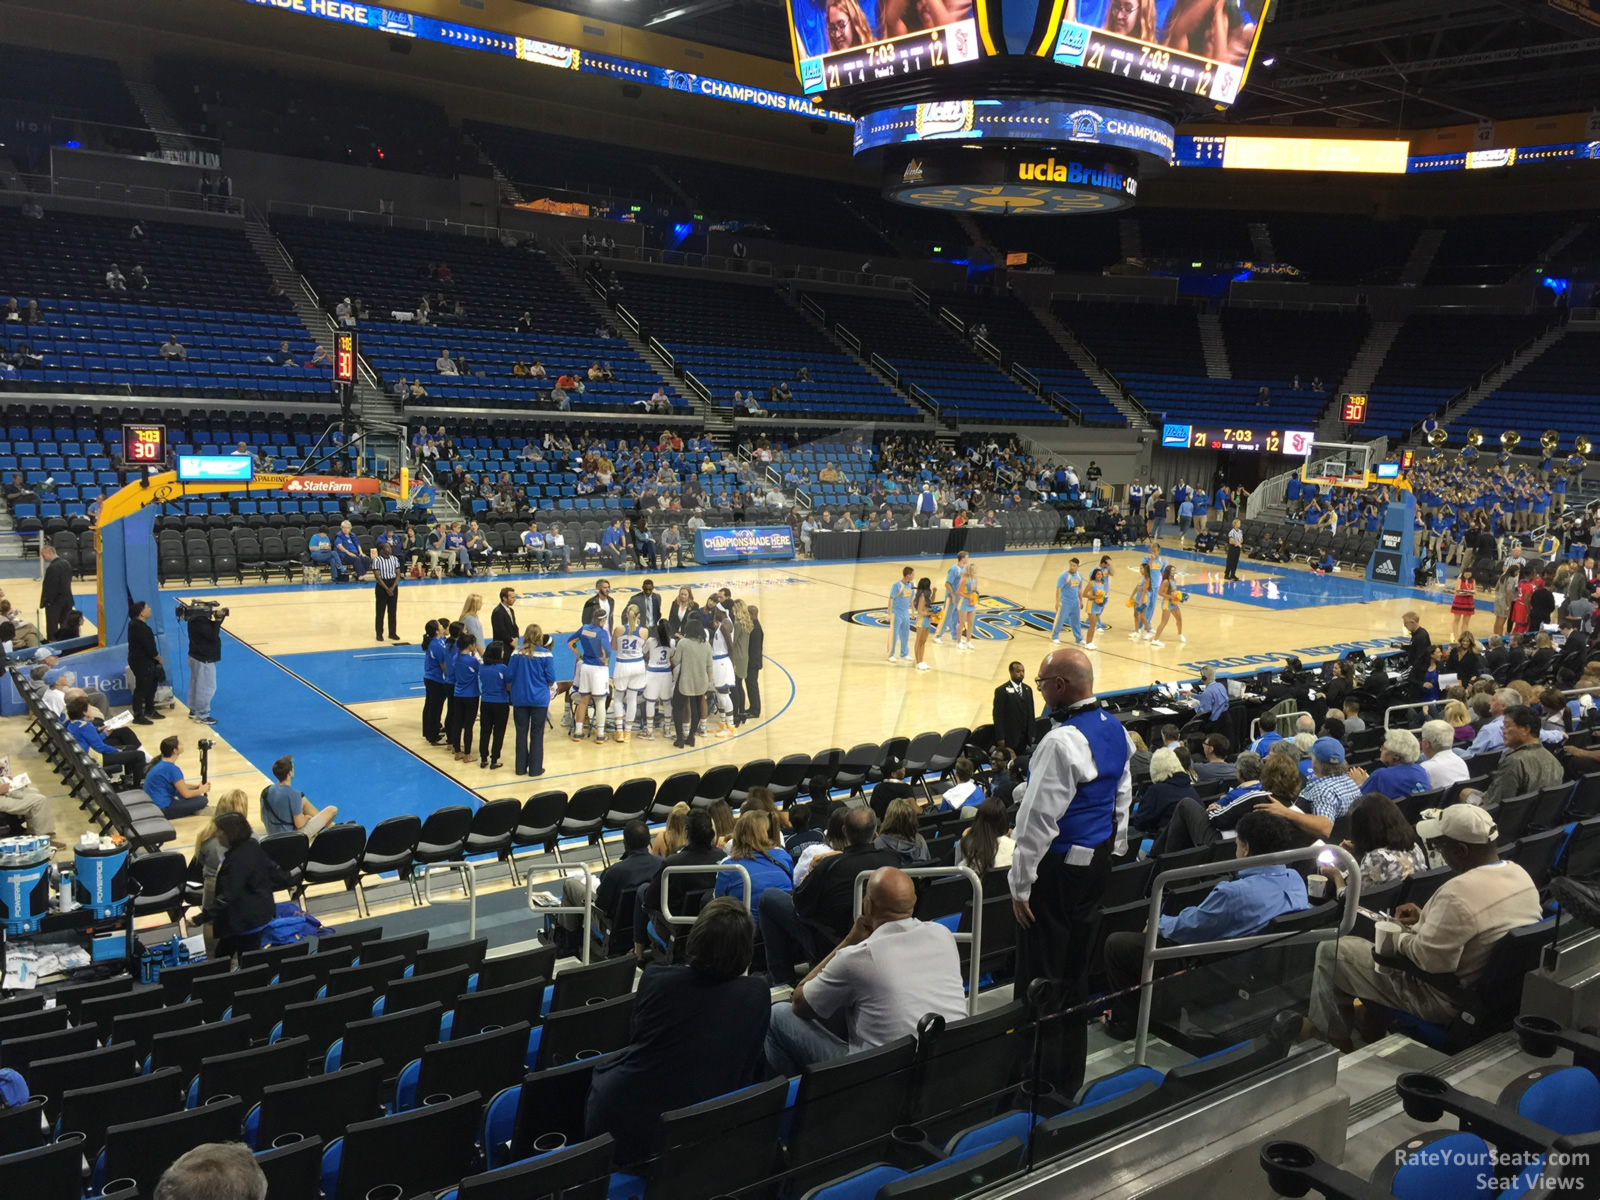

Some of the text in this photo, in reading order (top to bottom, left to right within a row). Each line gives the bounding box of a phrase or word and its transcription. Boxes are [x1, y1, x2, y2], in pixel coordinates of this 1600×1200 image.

[866, 43, 896, 66] 7:03
[929, 41, 944, 66] 12
[1087, 43, 1105, 68] 21
[1139, 46, 1170, 71] 7:03
[903, 58, 909, 73] 3
[828, 64, 840, 88] 21
[1195, 71, 1212, 95] 12
[701, 81, 786, 108] CHAMPIONS
[1106, 120, 1168, 147] CHAMPIONS
[1478, 131, 1490, 140] 42
[339, 353, 352, 377] 30
[1350, 396, 1365, 405] 7:03
[1346, 405, 1361, 420] 30
[135, 431, 160, 442] 7:03
[1195, 432, 1207, 447] 21
[1223, 428, 1252, 441] 7:03
[135, 443, 155, 457] 30
[1266, 437, 1280, 451] 12
[704, 535, 791, 548] CHAMPIONS MADE HERE
[1375, 568, 1397, 576] adidas
[622, 639, 637, 649] 24
[660, 650, 667, 661] 3
